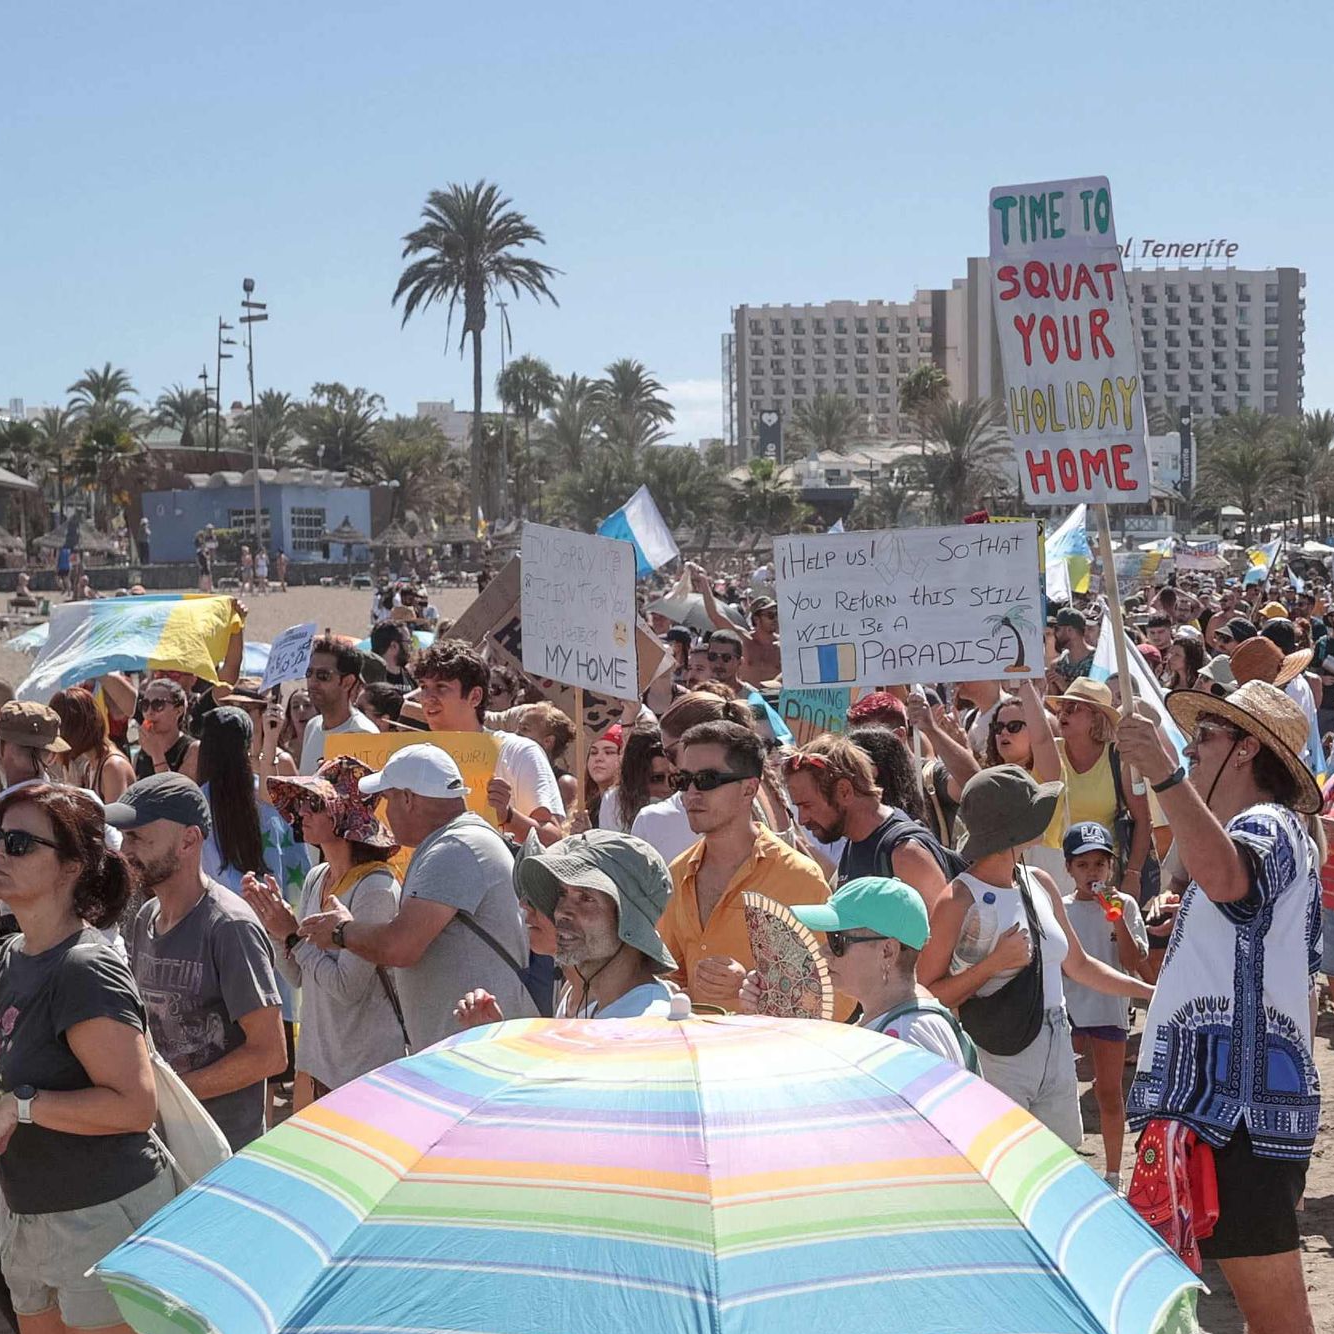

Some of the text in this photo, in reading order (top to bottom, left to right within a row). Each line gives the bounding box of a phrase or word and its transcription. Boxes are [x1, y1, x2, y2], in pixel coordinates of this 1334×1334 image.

[992, 187, 1110, 245] TIME TO
[1141, 239, 1239, 258] Tenerife
[997, 261, 1118, 301] SQUAT
[1014, 308, 1115, 366] YOUR
[1010, 376, 1138, 434] HOLIDAY
[1025, 444, 1138, 495] HOME
[796, 624, 850, 643] WILL
[893, 616, 908, 632] A
[545, 643, 628, 689] MY HOME
[862, 635, 1014, 675] PARADISE
[1081, 826, 1105, 844] LA
